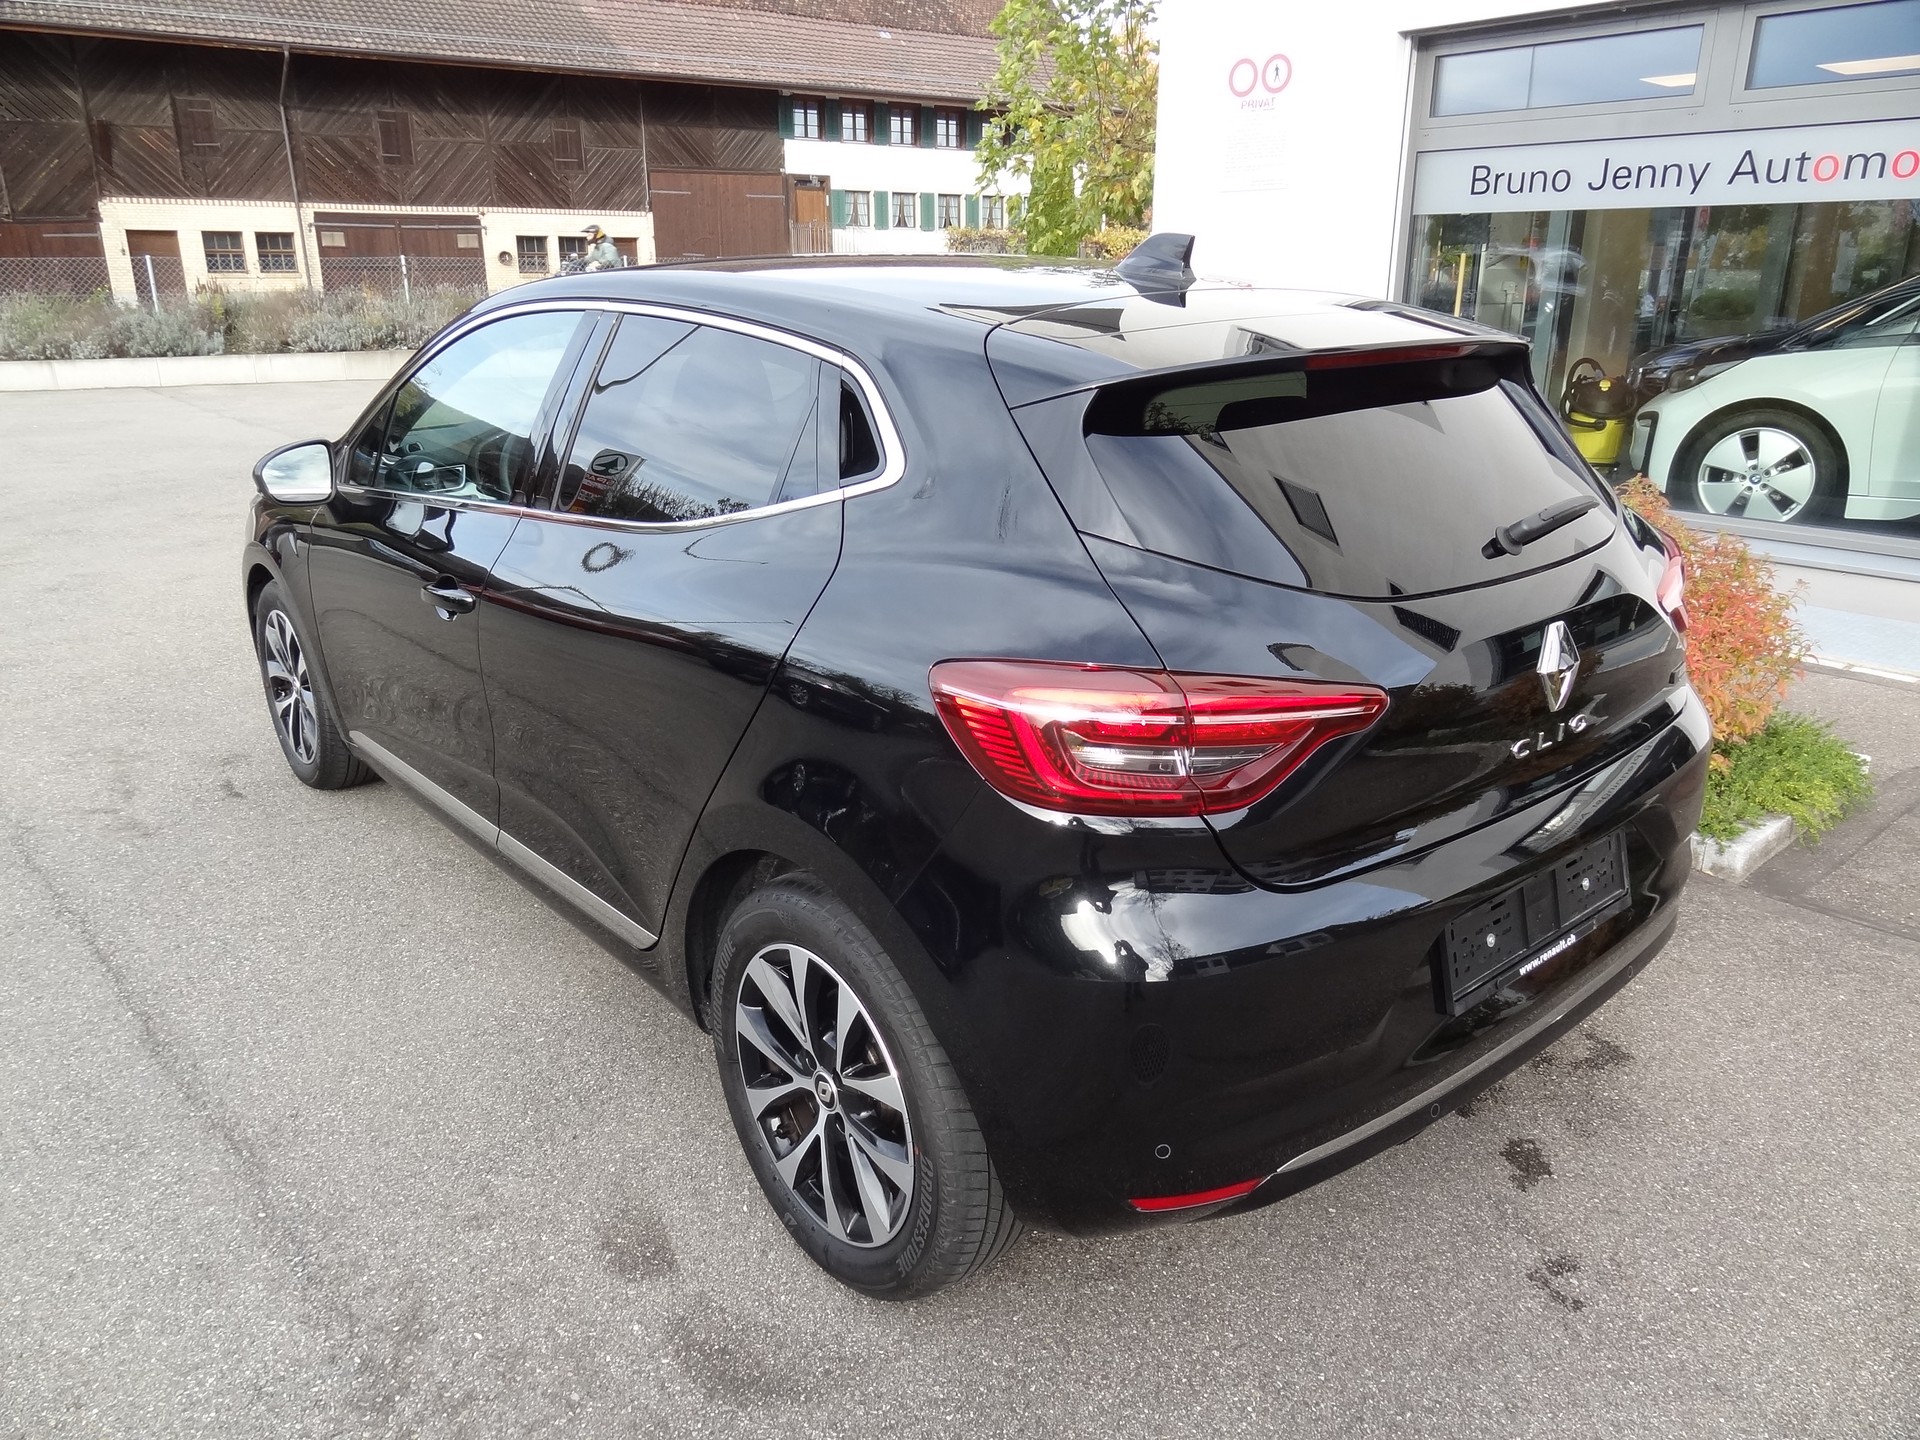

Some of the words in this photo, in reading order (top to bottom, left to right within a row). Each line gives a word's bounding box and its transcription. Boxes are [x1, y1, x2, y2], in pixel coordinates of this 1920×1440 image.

[1240, 97, 1277, 110] PRIVAT
[1469, 164, 1572, 196] Bruno
[1587, 157, 1712, 195] Jenny
[1726, 149, 1920, 186] Automo
[1510, 714, 1587, 759] CLIO
[1519, 933, 1576, 976] www.renault.ch
[895, 1152, 934, 1278] BRIDGESTONE
